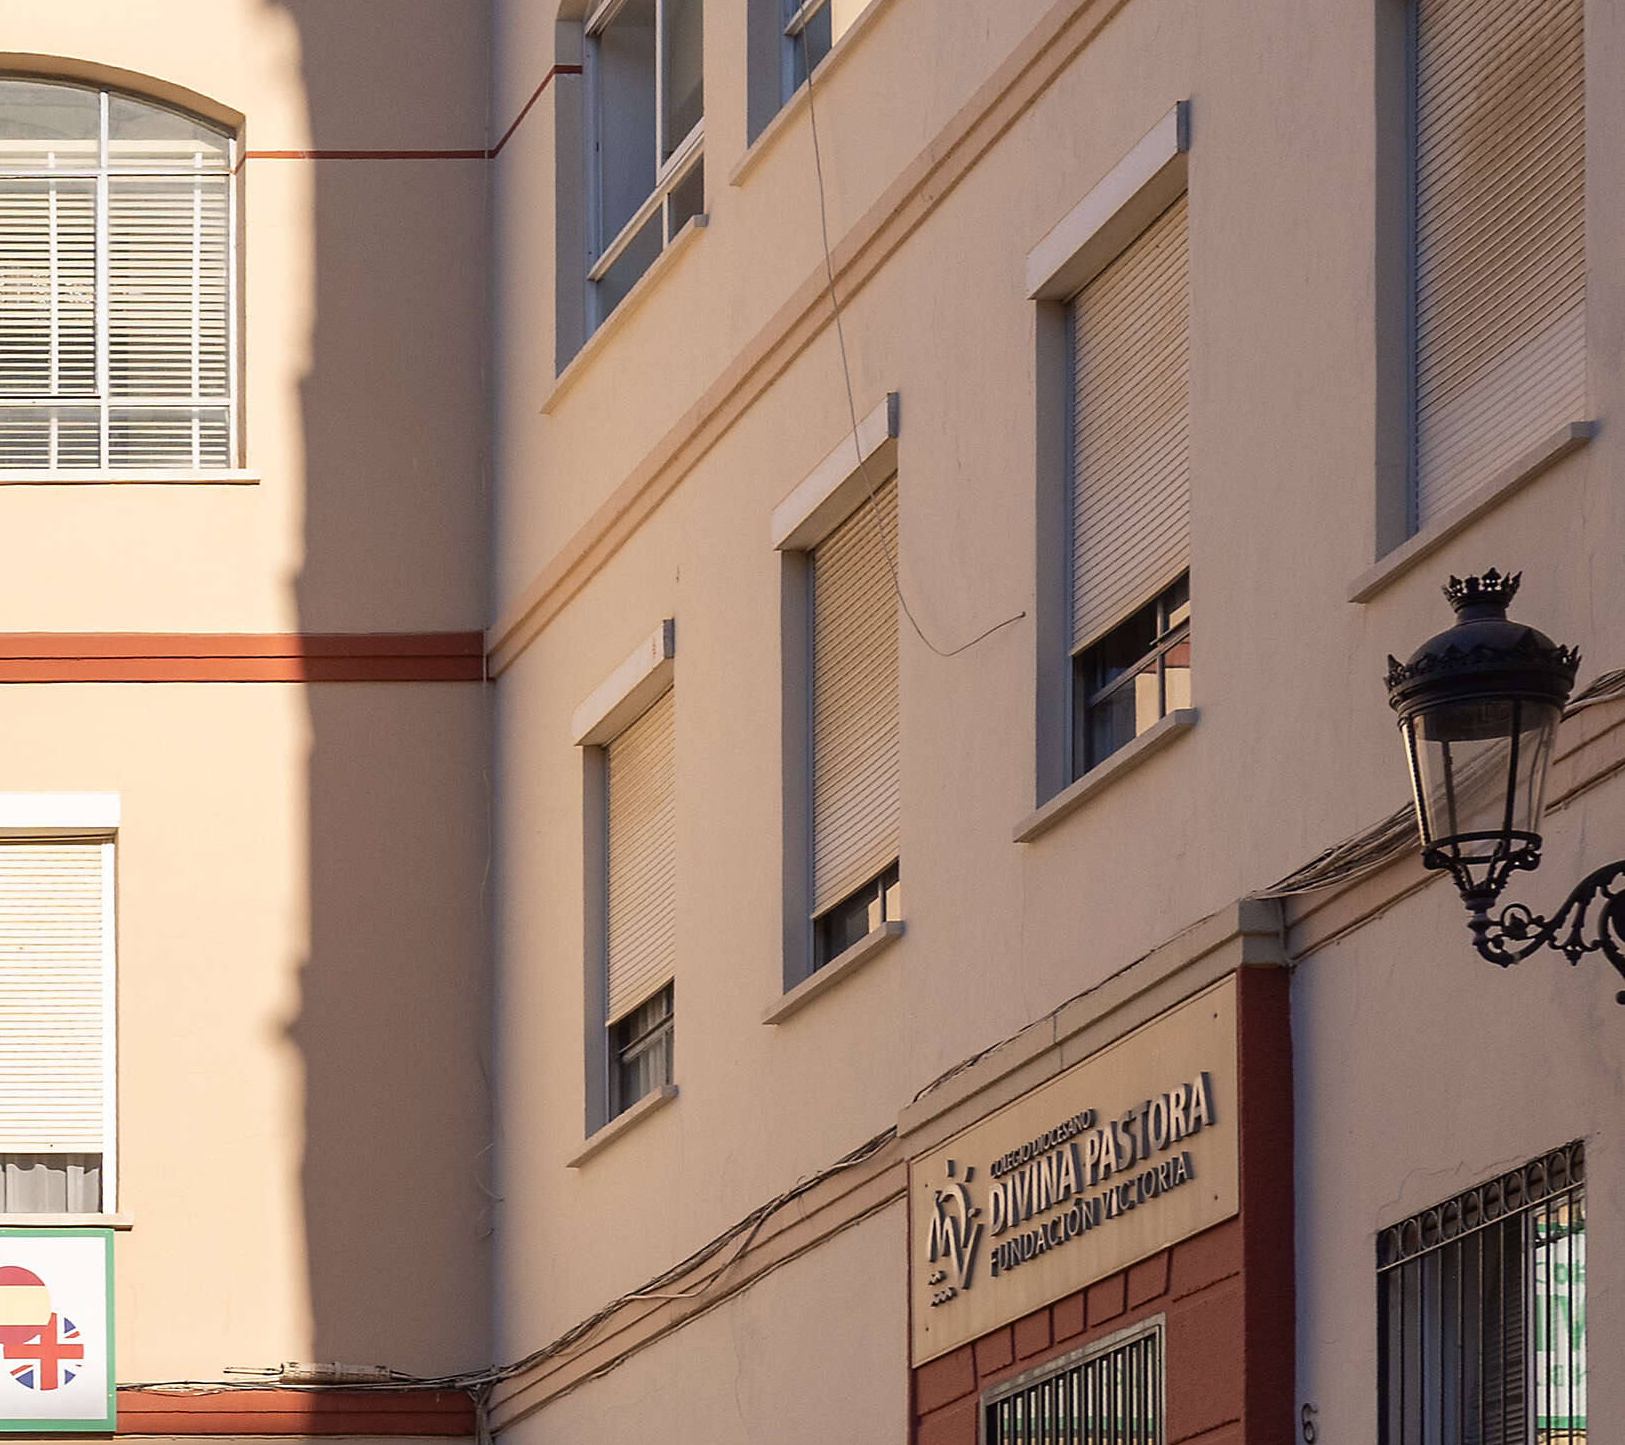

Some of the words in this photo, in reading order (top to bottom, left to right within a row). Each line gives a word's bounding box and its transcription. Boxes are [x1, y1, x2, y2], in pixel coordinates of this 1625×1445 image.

[988, 1142, 1083, 1237] DIVINA
[1085, 1071, 1215, 1187] PASTORA
[990, 1140, 1034, 1179] COLEGIO
[1031, 1107, 1096, 1156] DIOCESANO
[991, 1197, 1102, 1277] FUNDACIÓN
[1101, 1151, 1194, 1220] VICTORIA
[1301, 1402, 1319, 1445] 6
